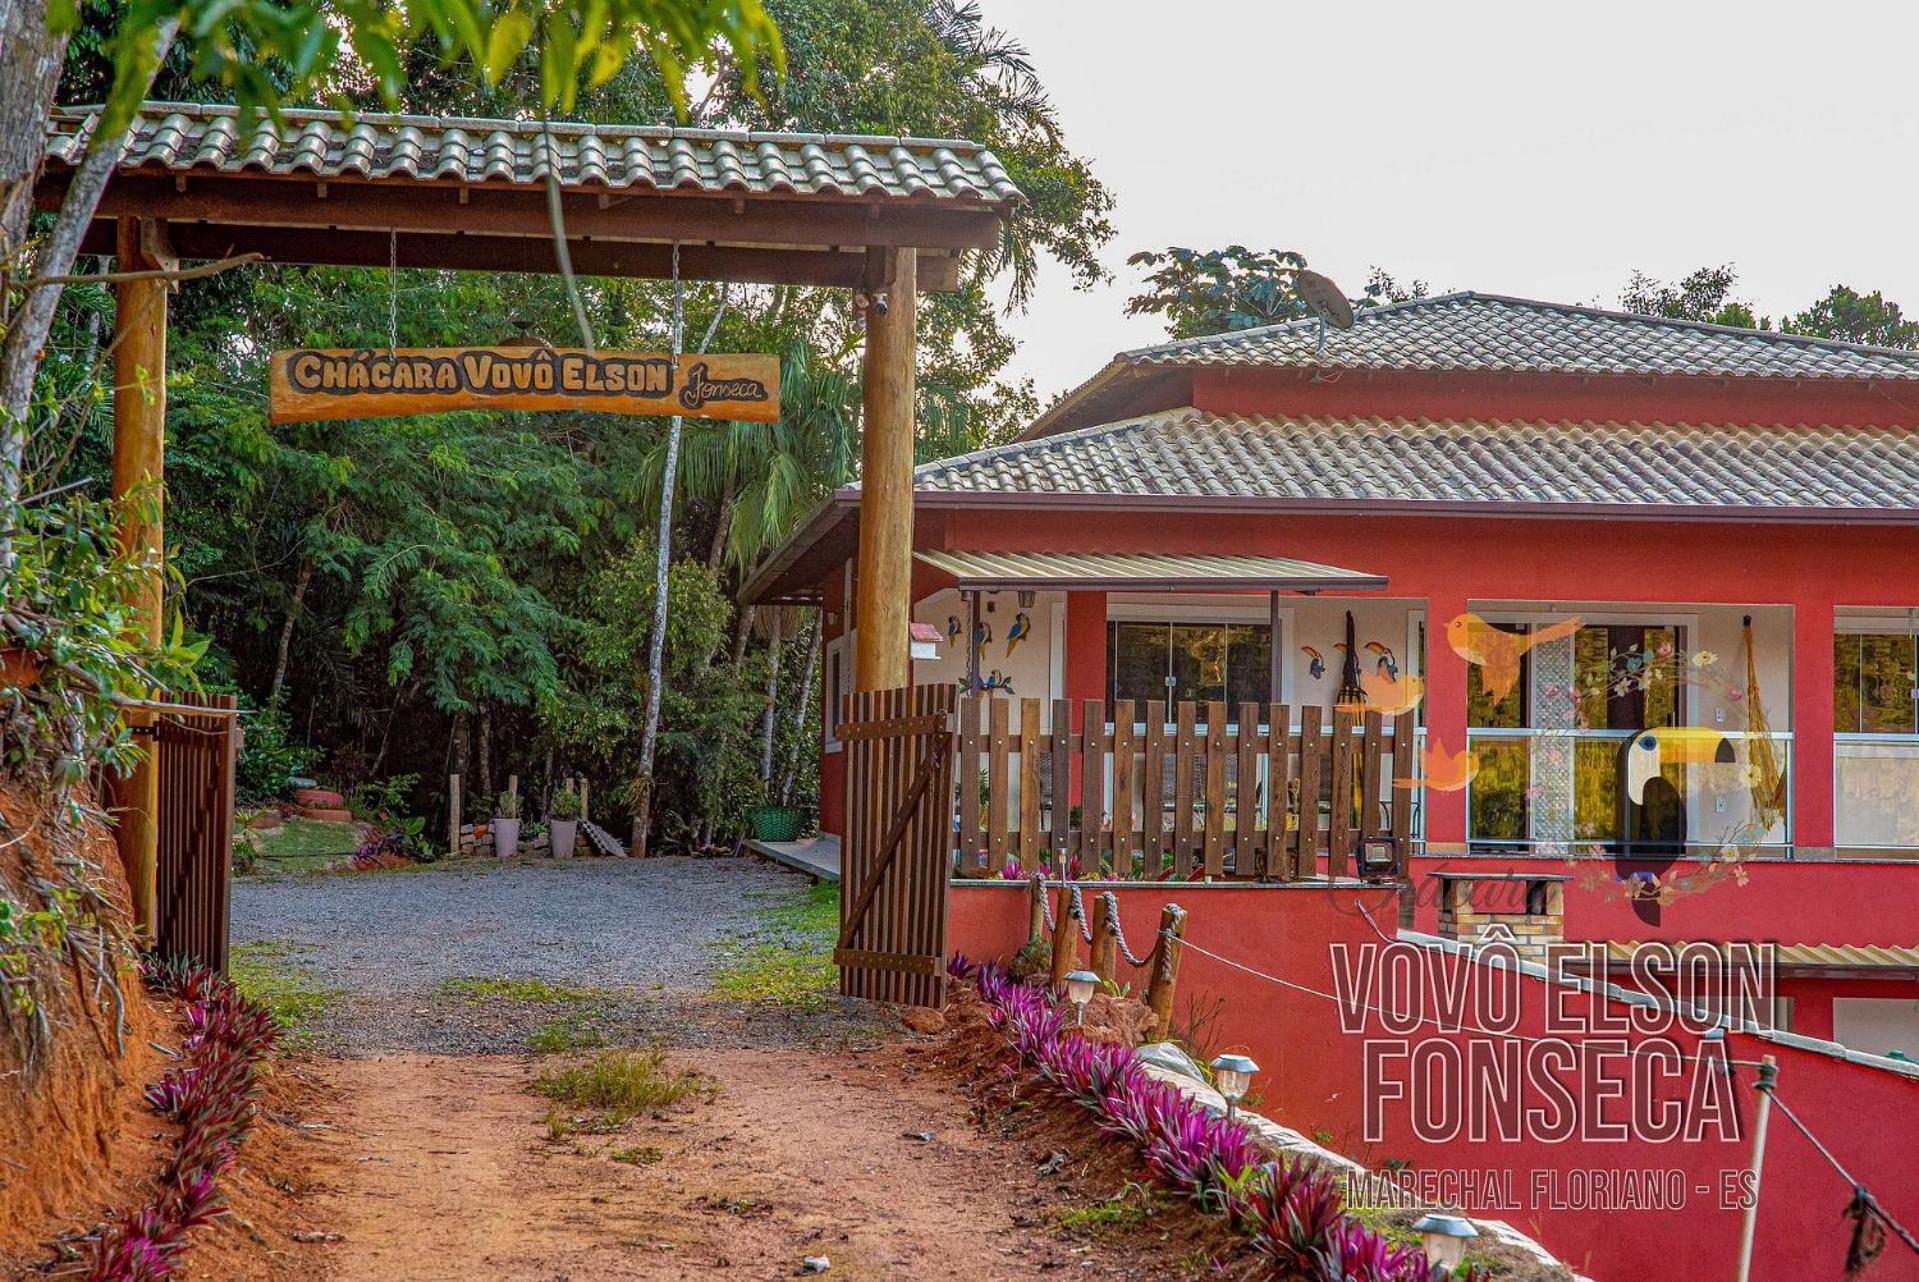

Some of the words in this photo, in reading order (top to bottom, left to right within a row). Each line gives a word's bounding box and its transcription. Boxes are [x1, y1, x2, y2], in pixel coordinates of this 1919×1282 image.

[294, 351, 458, 389] CHÁCARA
[463, 350, 554, 389] VOVÔ
[562, 357, 668, 392] ELSON
[683, 365, 762, 407] Fonseca
